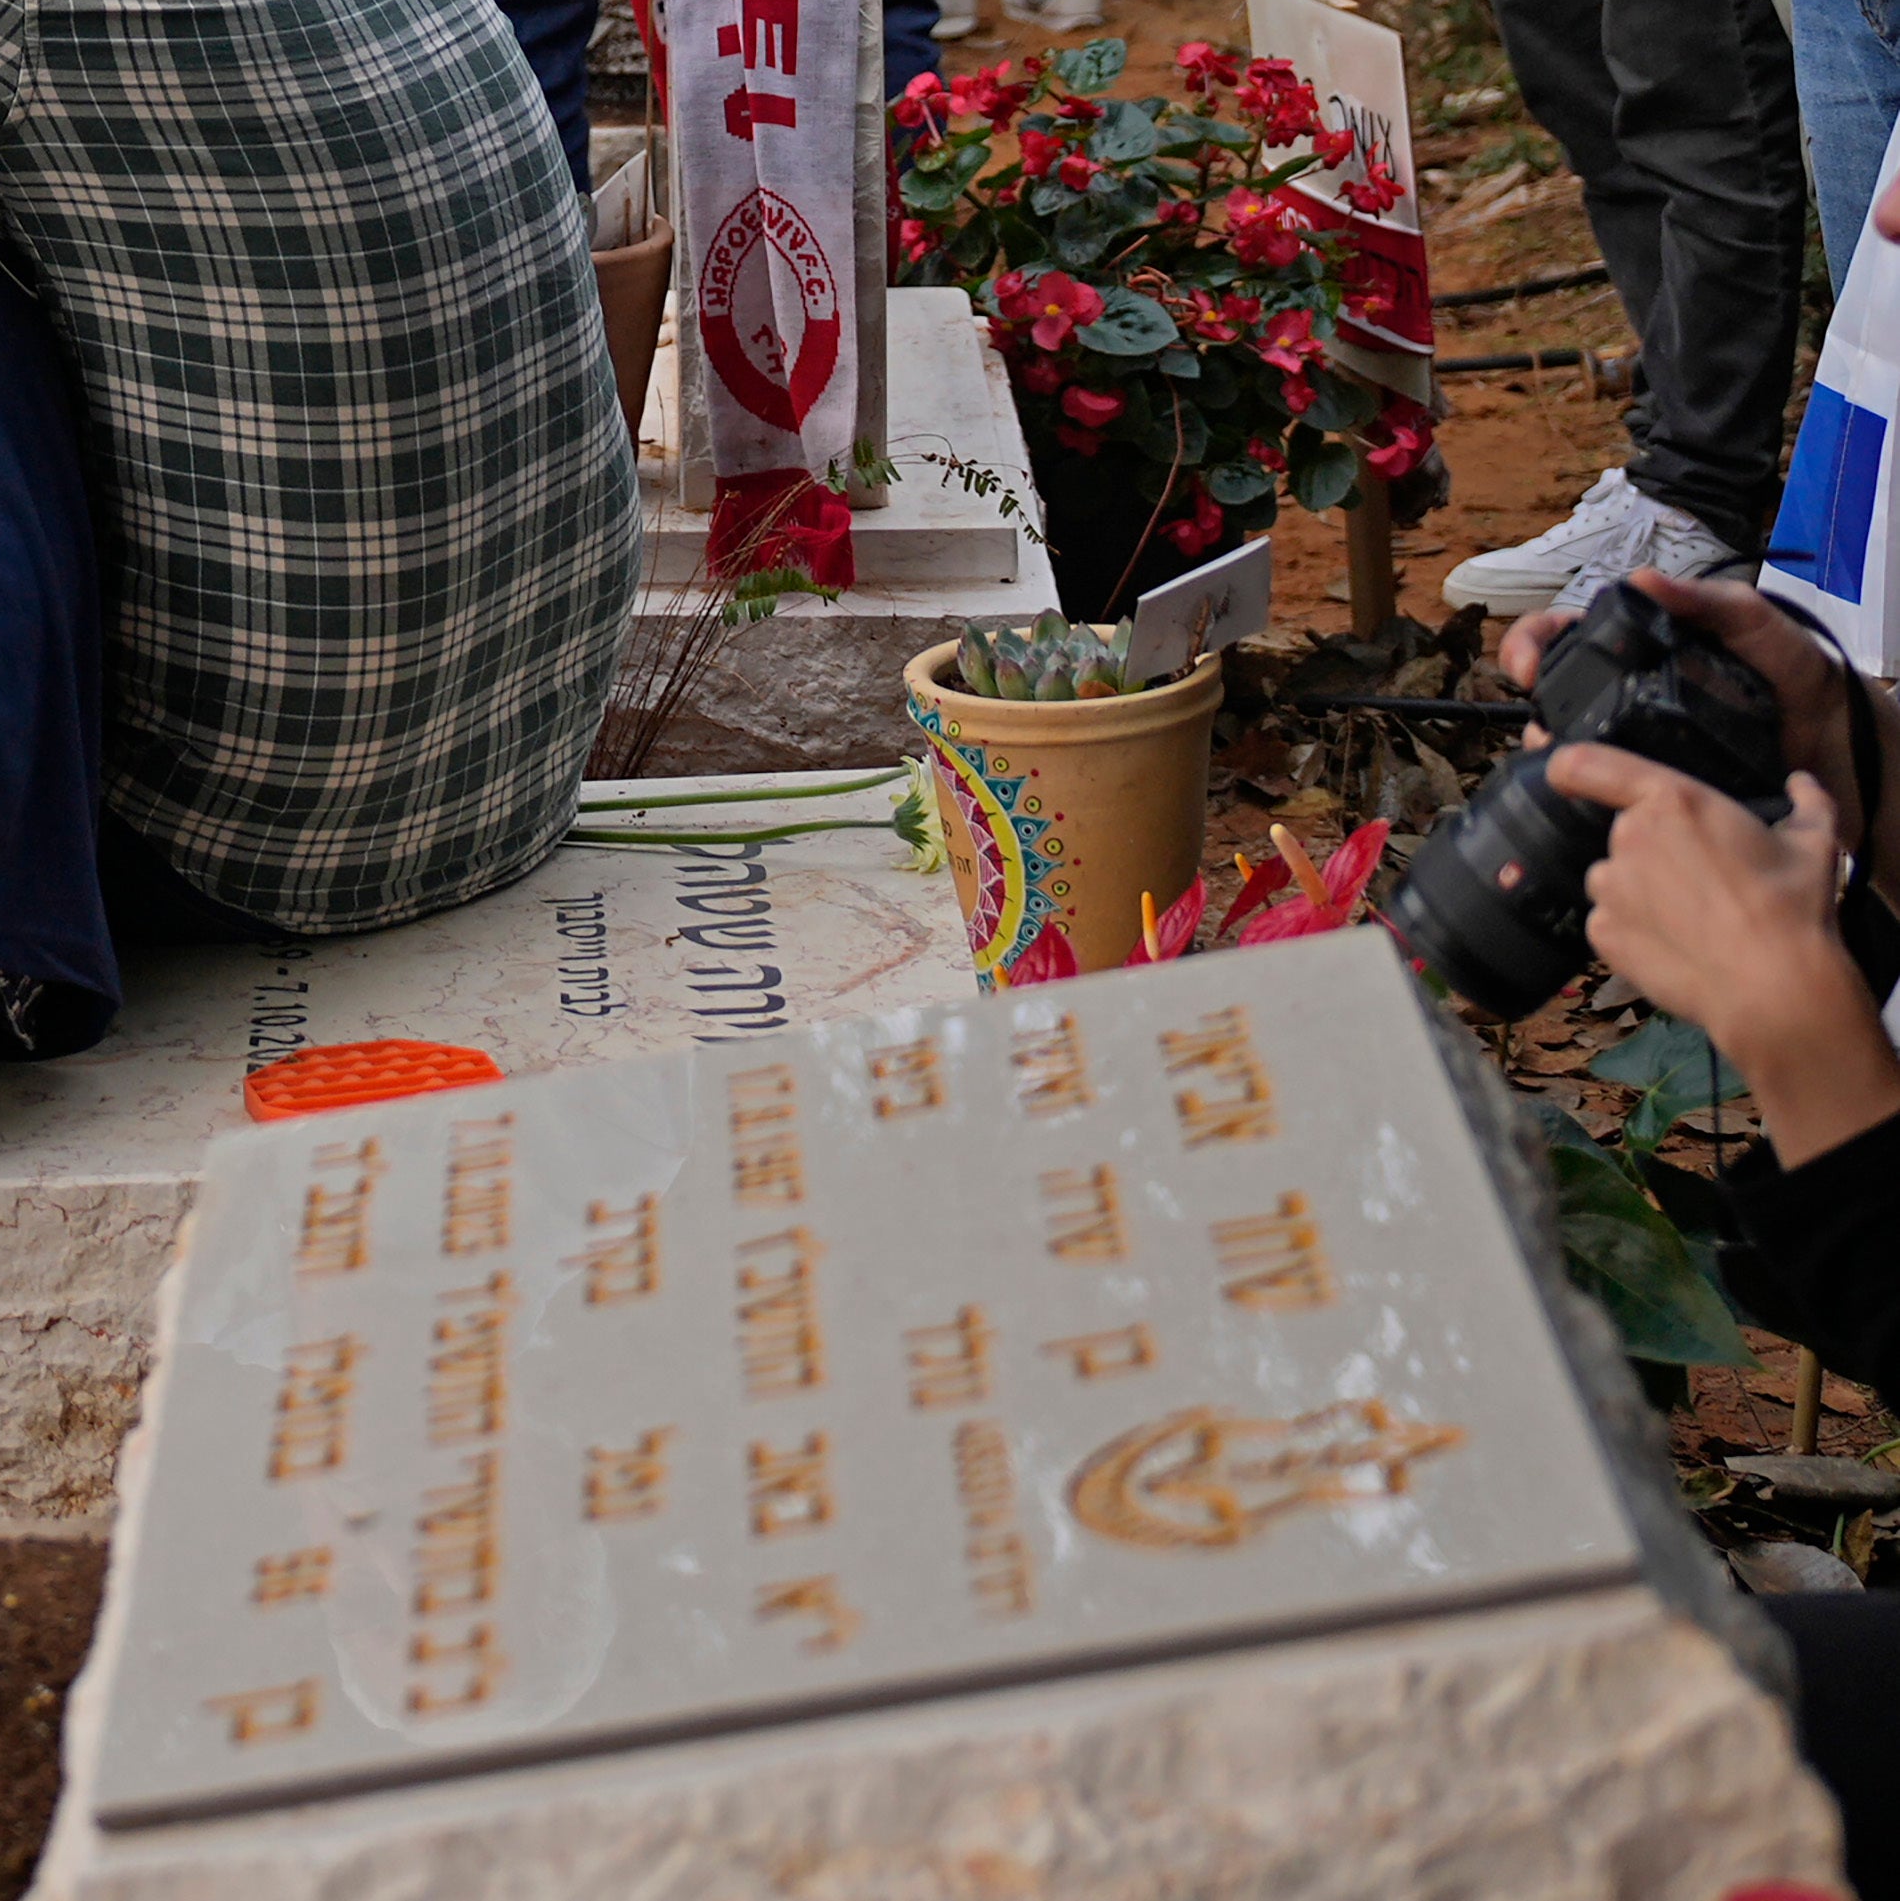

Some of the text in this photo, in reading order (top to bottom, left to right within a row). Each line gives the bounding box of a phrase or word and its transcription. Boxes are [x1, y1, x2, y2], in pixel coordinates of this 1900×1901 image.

[557, 966, 630, 1018] לבית
[246, 981, 310, 1076] 7.10.20
[1048, 1322, 1161, 1382] בן
[210, 1677, 323, 1746] בן
